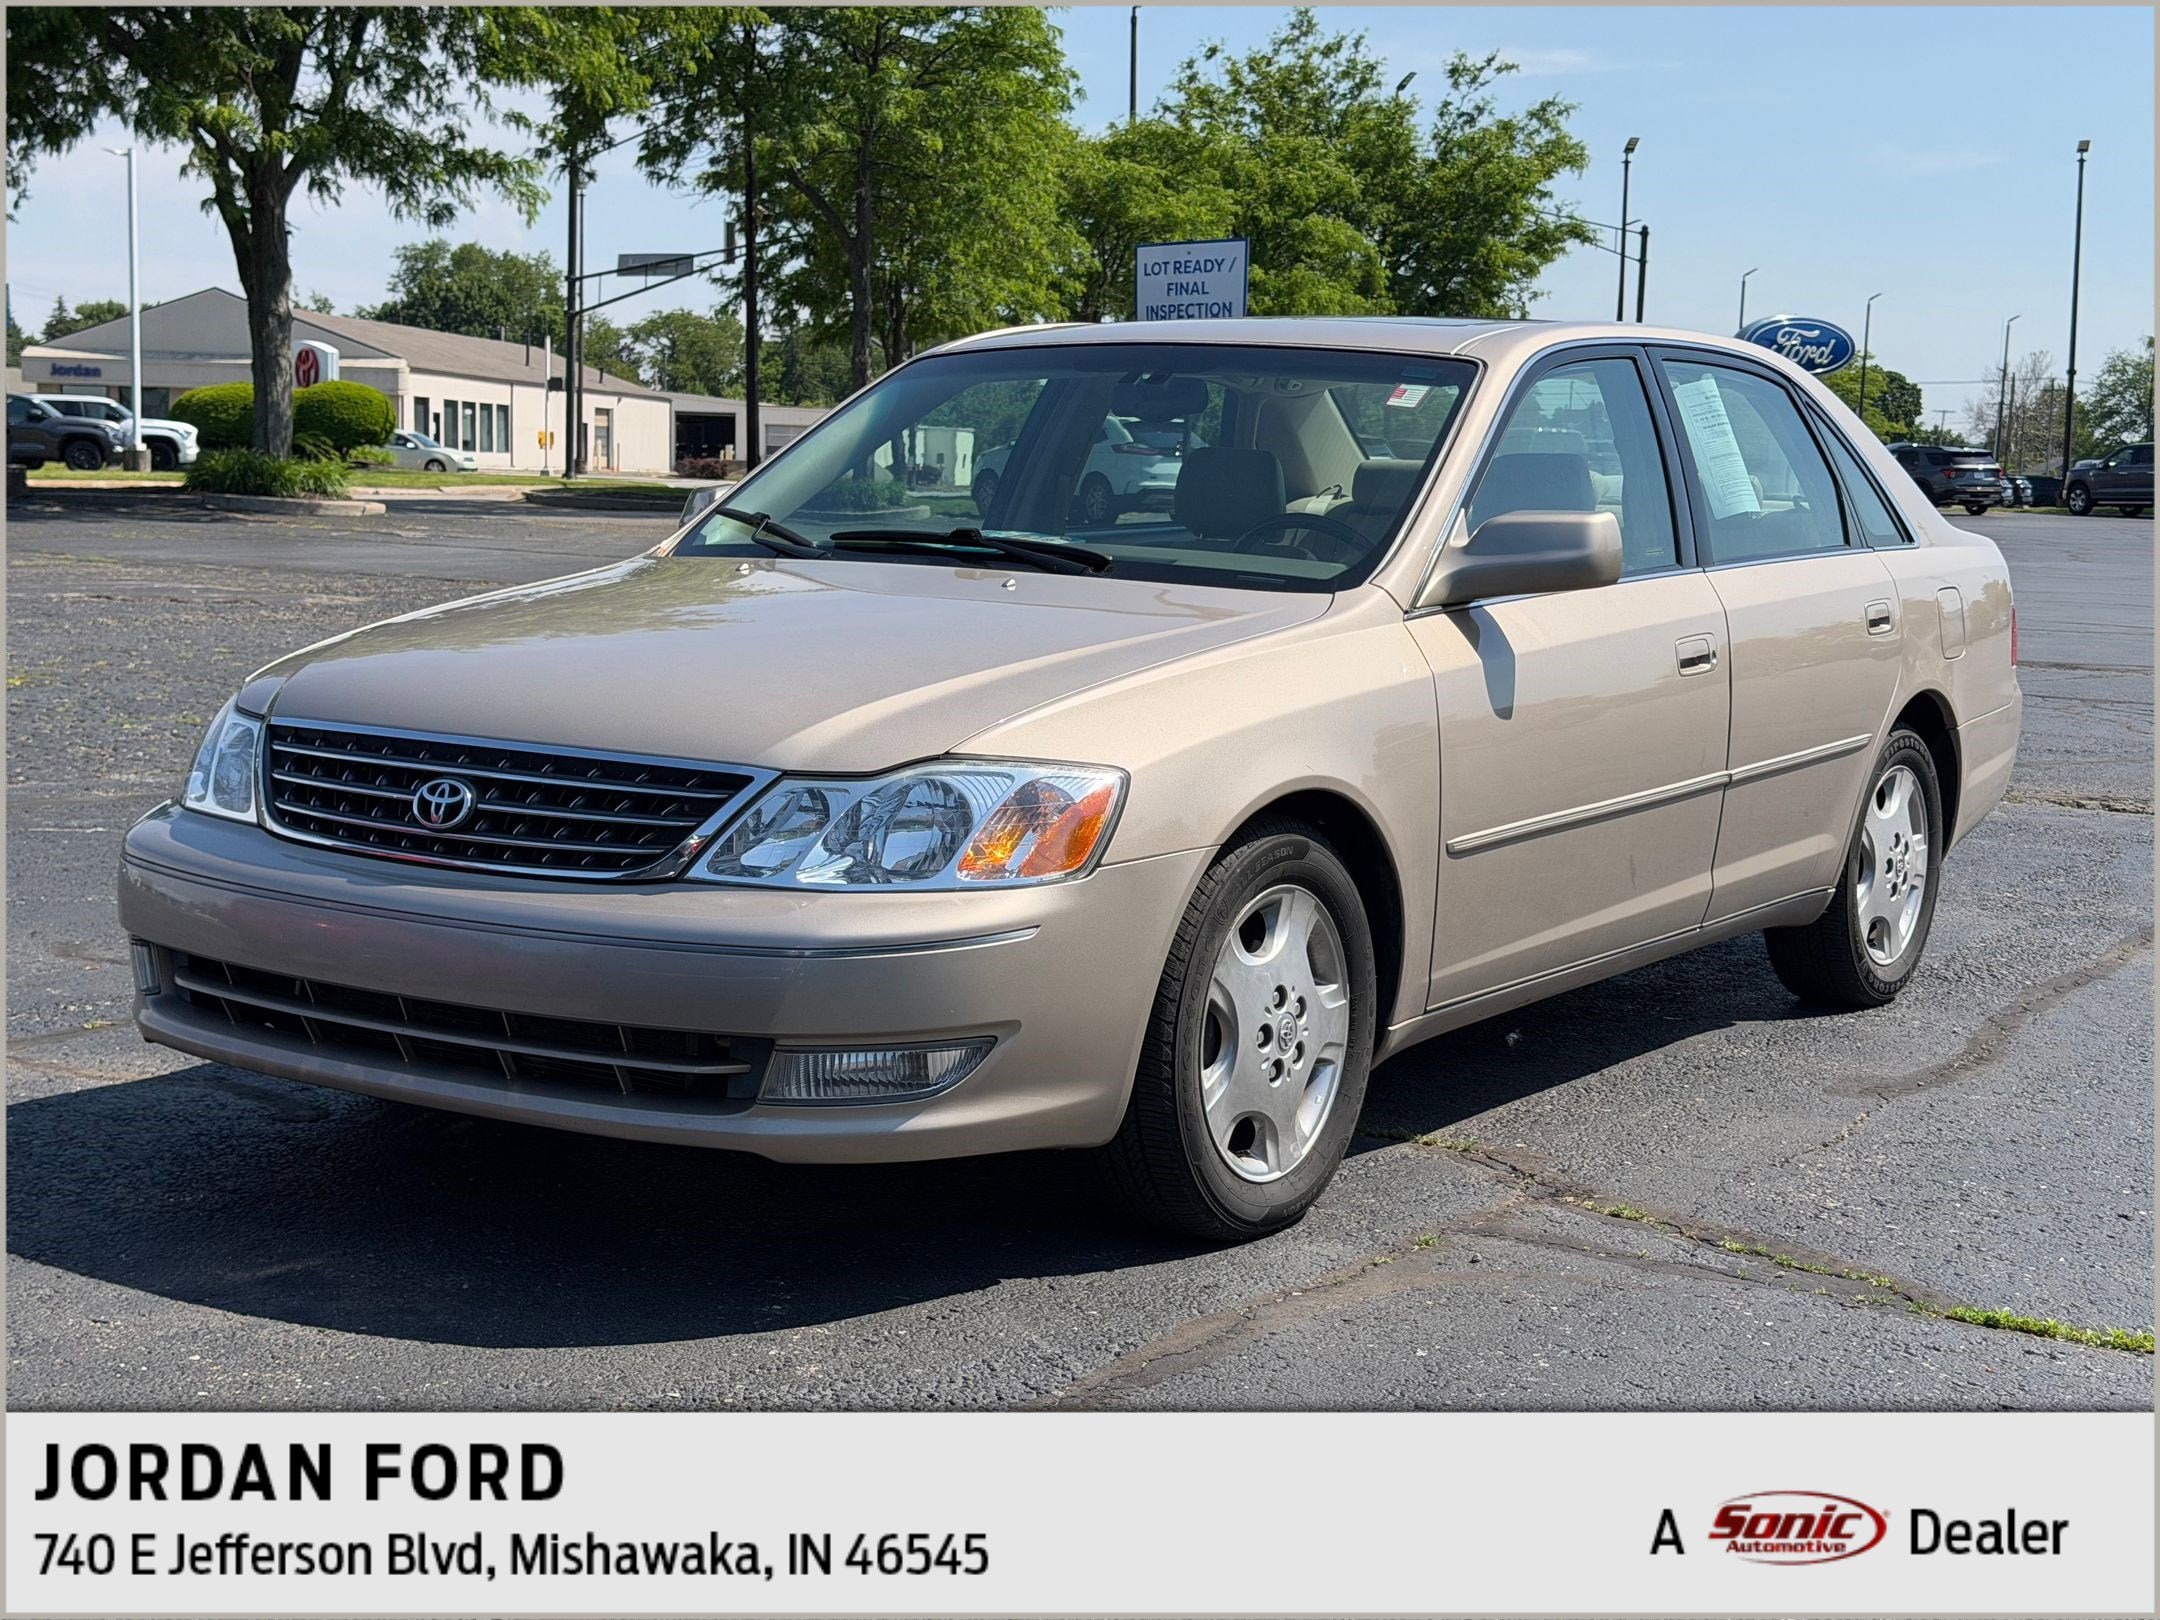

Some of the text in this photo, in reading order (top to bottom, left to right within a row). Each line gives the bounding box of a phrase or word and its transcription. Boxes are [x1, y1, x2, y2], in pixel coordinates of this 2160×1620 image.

[1143, 262, 1170, 276] LOT
[1173, 259, 1225, 275] READY
[1166, 281, 1210, 296] FINAL
[1146, 302, 1232, 320] INSPECTION
[1771, 327, 1836, 364] Ford
[50, 363, 102, 377] Jordan
[1255, 846, 1294, 873] SEASON
